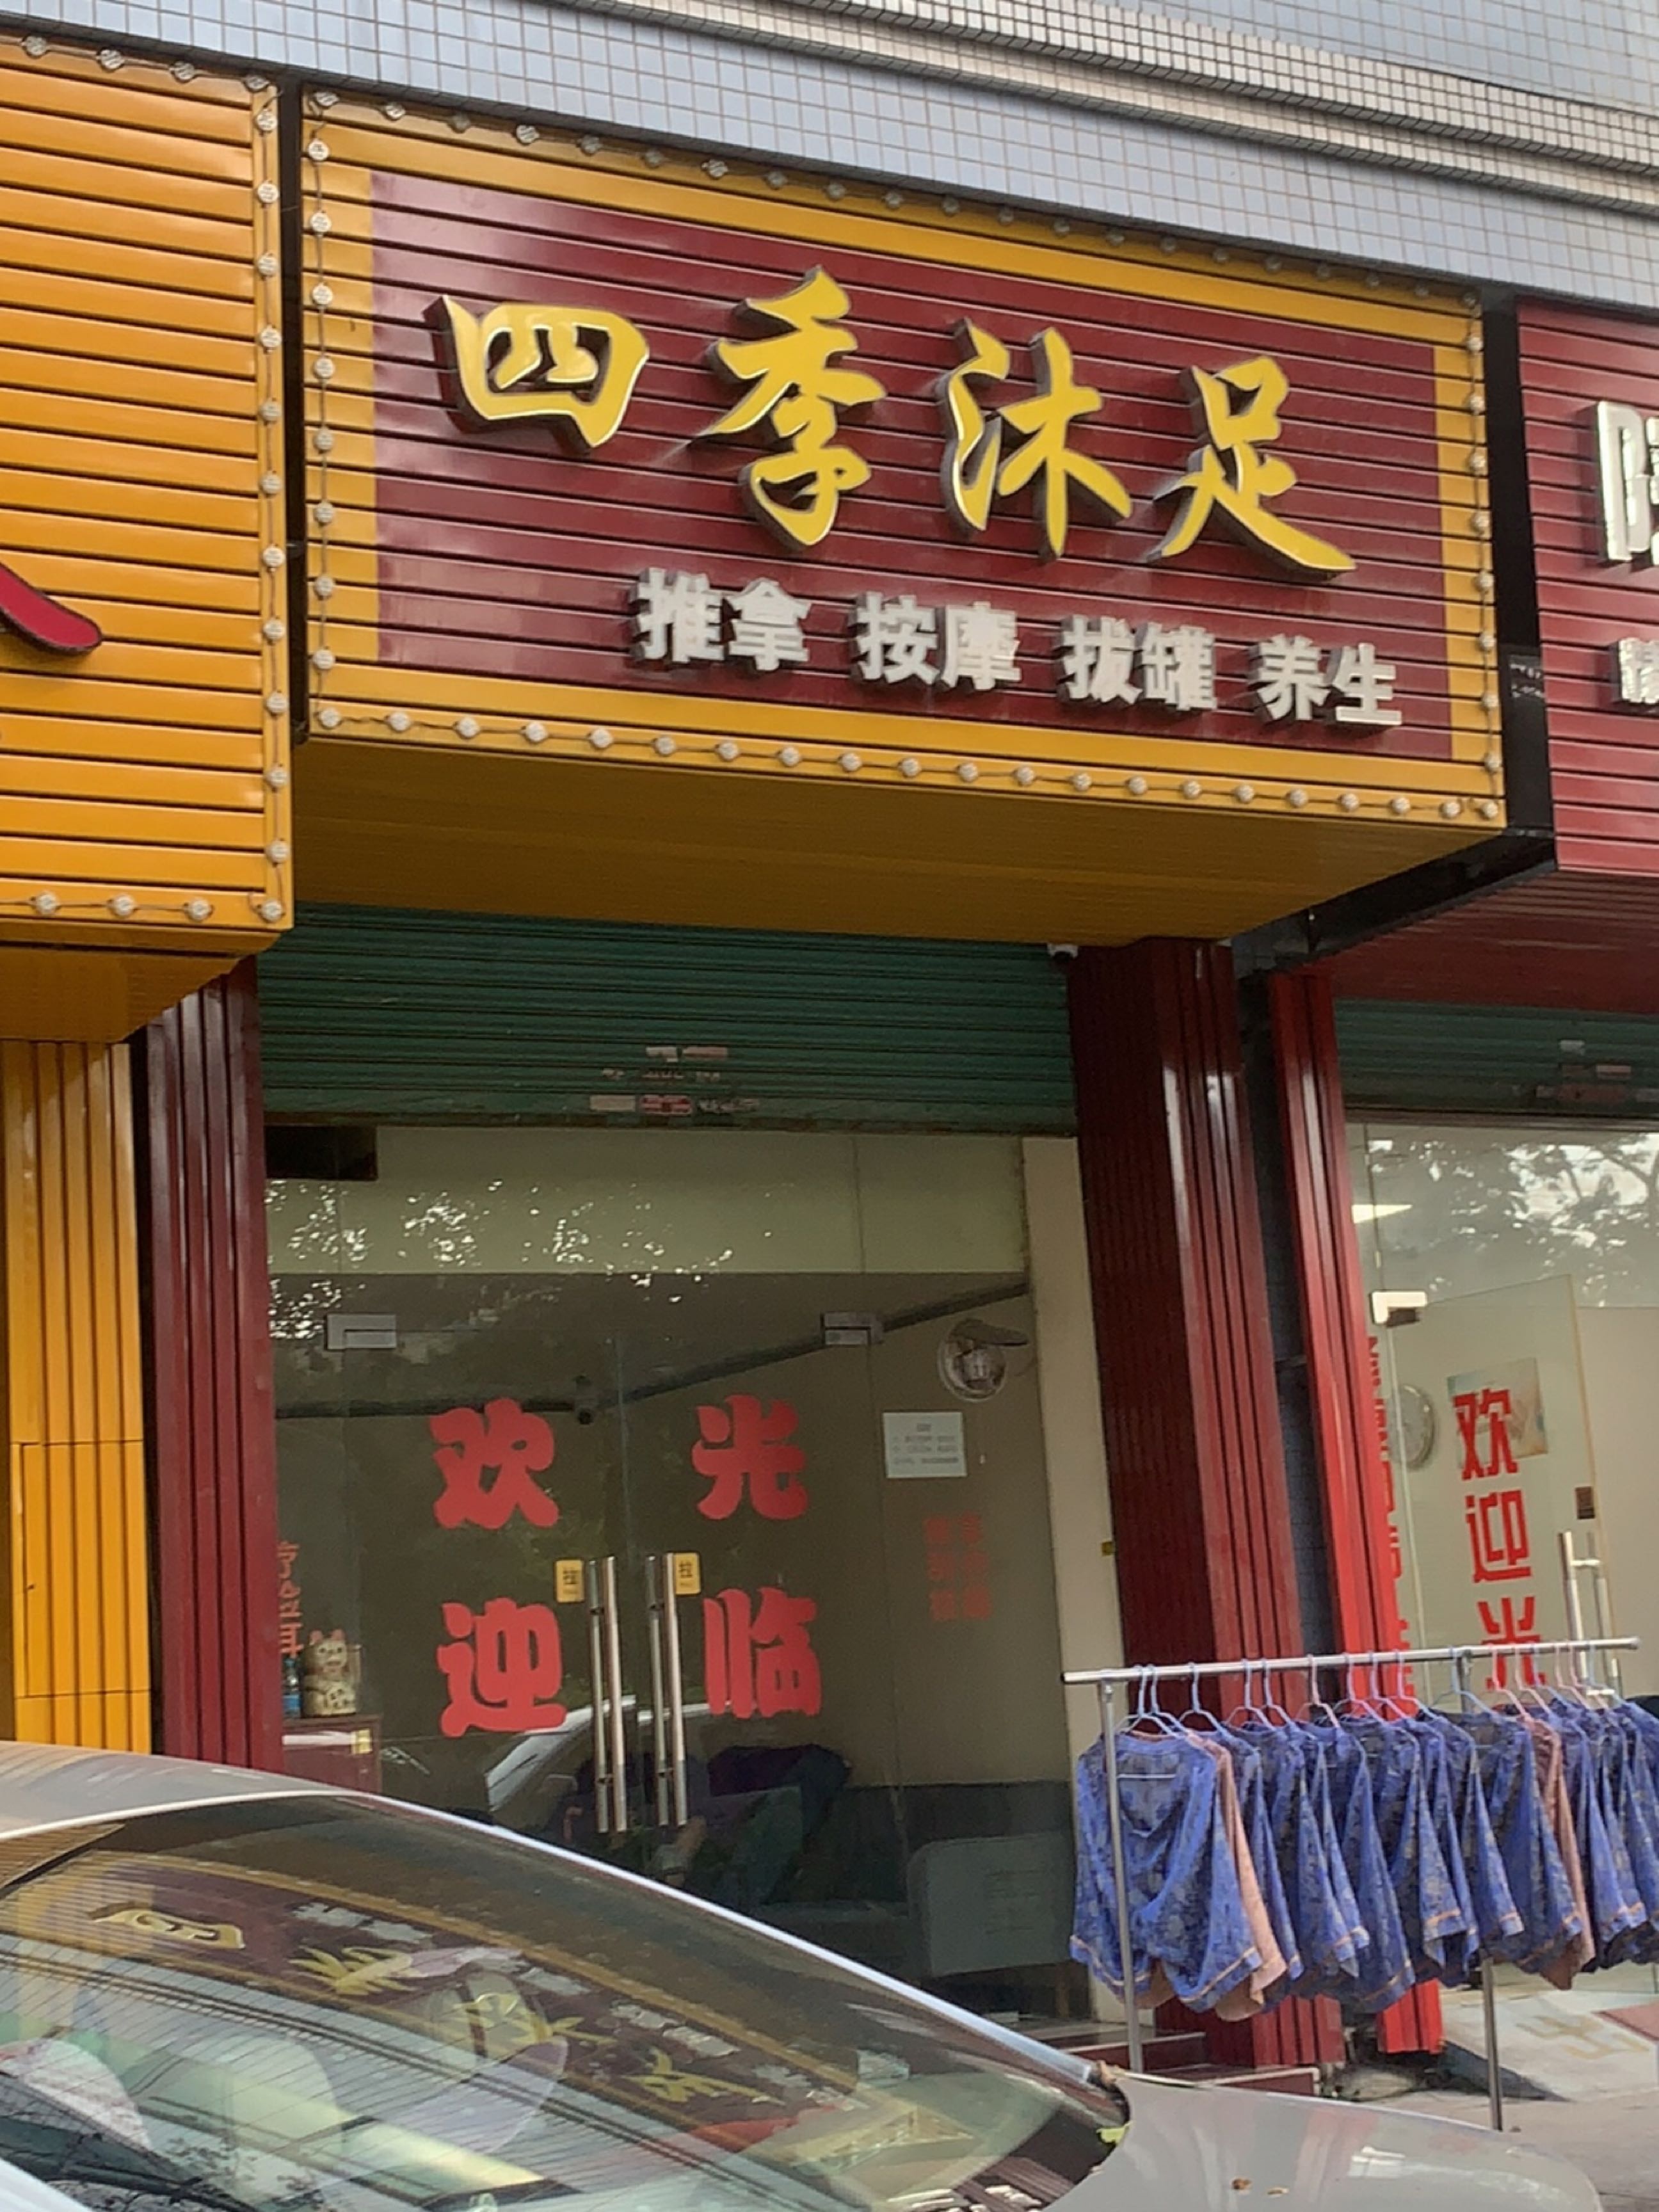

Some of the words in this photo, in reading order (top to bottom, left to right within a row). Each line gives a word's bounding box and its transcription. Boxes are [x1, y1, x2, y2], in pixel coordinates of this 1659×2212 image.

[433, 267, 1354, 577] 四季沐足
[635, 568, 809, 669] 推拿
[856, 591, 1023, 690] 按摩
[1057, 614, 1217, 710] 拔罐
[1256, 634, 1403, 727] 养生
[429, 1398, 567, 1736] 欢迎
[692, 1395, 822, 1719] 光临
[1452, 1388, 1547, 1709] 欢迎光
